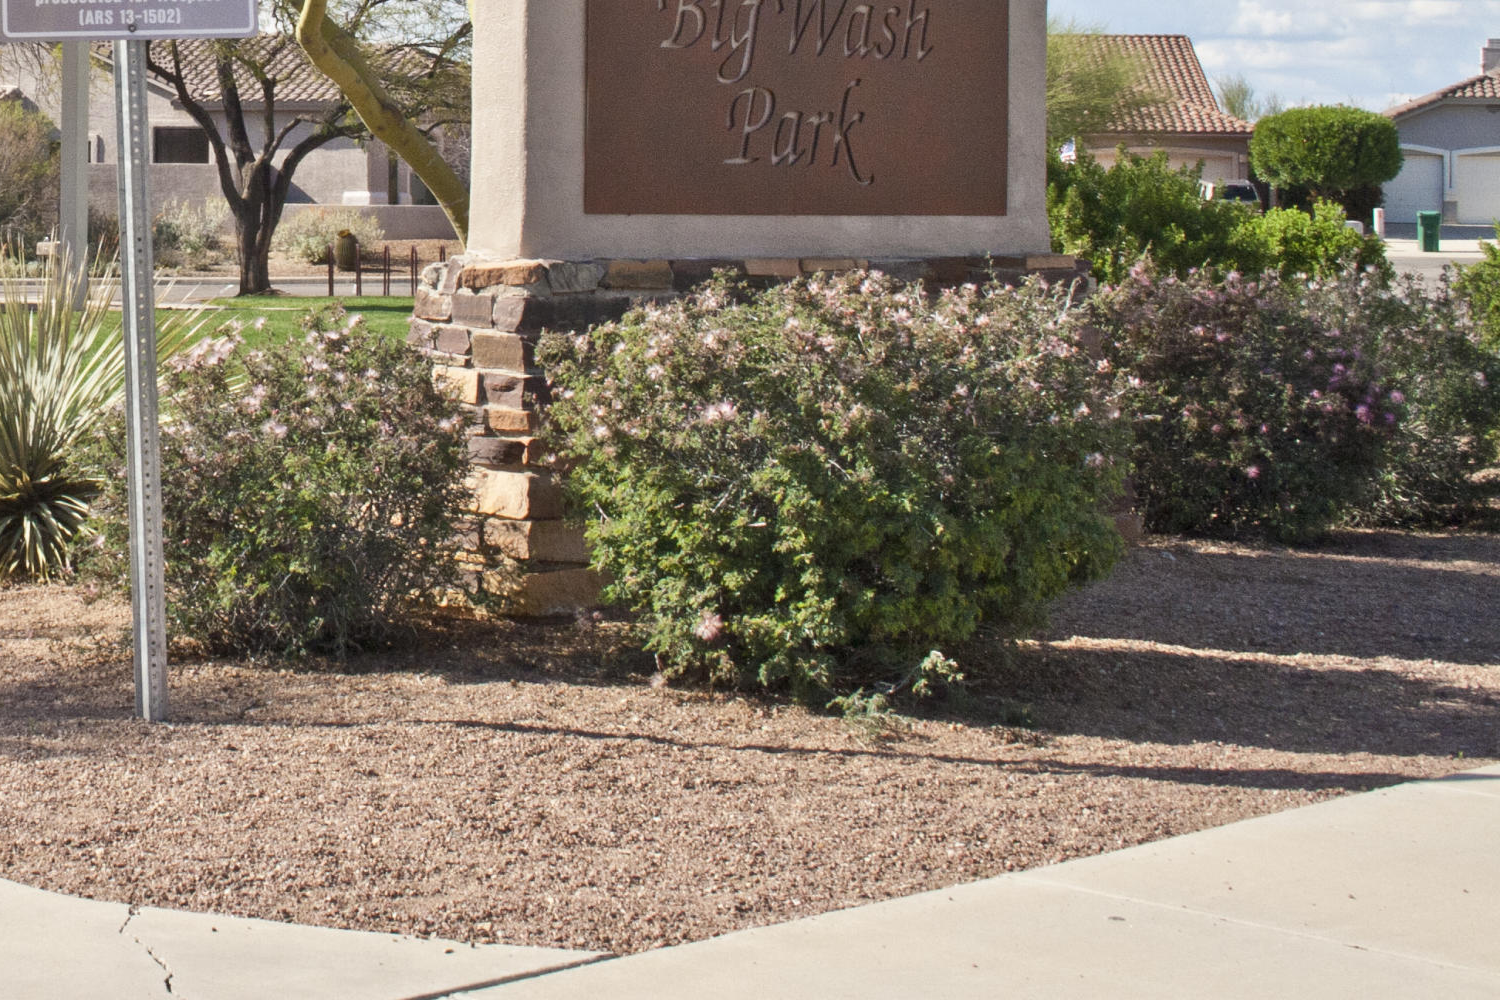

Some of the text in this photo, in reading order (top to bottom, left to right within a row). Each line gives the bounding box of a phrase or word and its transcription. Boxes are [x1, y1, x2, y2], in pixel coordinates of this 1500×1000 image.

[79, 8, 181, 25] (ARS 13-1502)
[722, 78, 875, 186] Park
